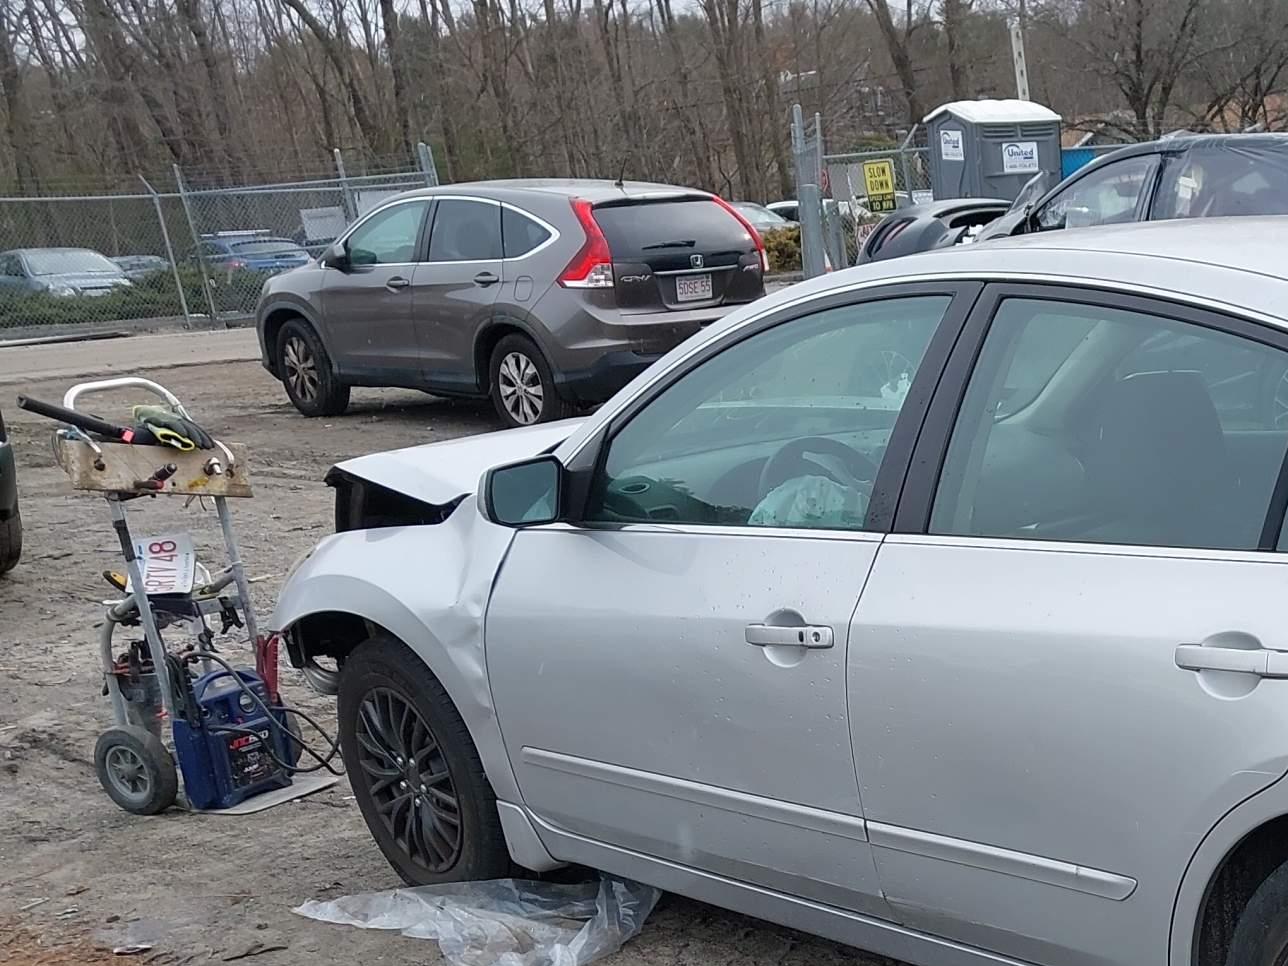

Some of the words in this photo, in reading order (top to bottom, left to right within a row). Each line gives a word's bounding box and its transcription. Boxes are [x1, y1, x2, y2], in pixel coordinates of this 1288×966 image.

[1007, 147, 1034, 157] United
[868, 167, 887, 178] SLOW
[870, 179, 890, 191] DOWN
[872, 201, 880, 210] 10
[678, 281, 698, 296] 5DSE
[701, 279, 711, 292] 55
[148, 540, 178, 562] 48
